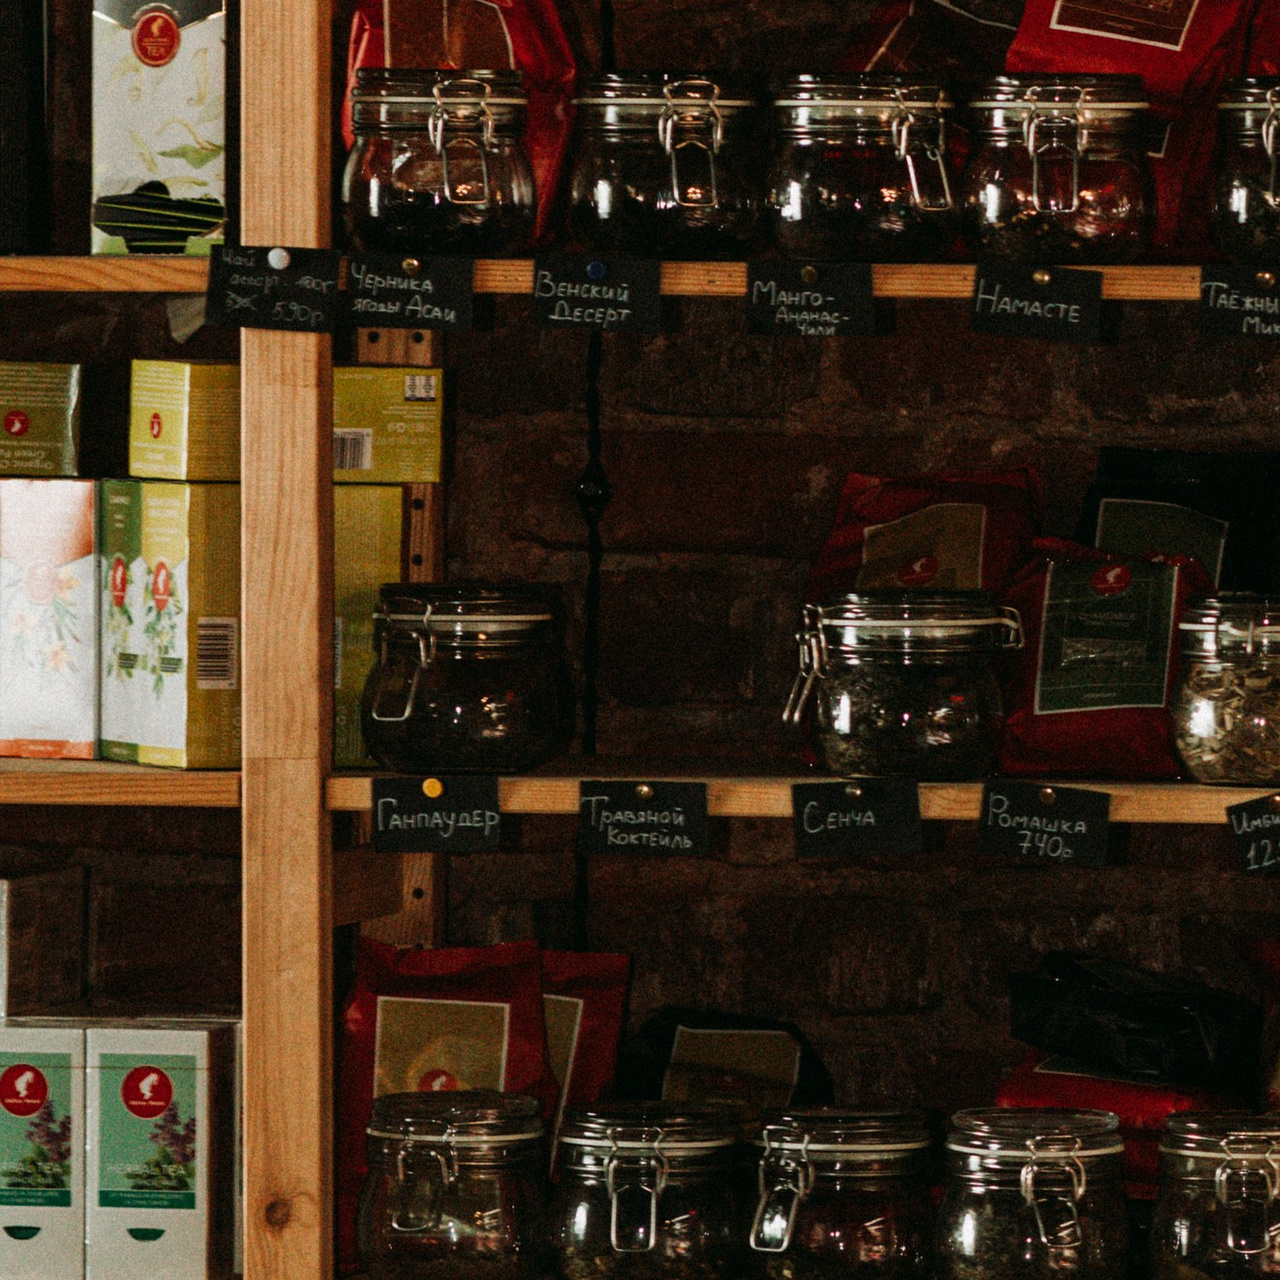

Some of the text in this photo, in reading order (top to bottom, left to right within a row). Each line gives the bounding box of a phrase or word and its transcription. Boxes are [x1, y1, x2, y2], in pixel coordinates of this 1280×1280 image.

[351, 263, 433, 295] Черника
[535, 271, 630, 301] Венский
[549, 300, 631, 328] Десерт
[976, 278, 1080, 322] Намасте
[378, 798, 499, 837] Ганпаудер
[581, 796, 684, 832] Травяной
[804, 801, 875, 833] Сенча
[989, 792, 1086, 833] Ромашка
[607, 825, 692, 848] Коктейль
